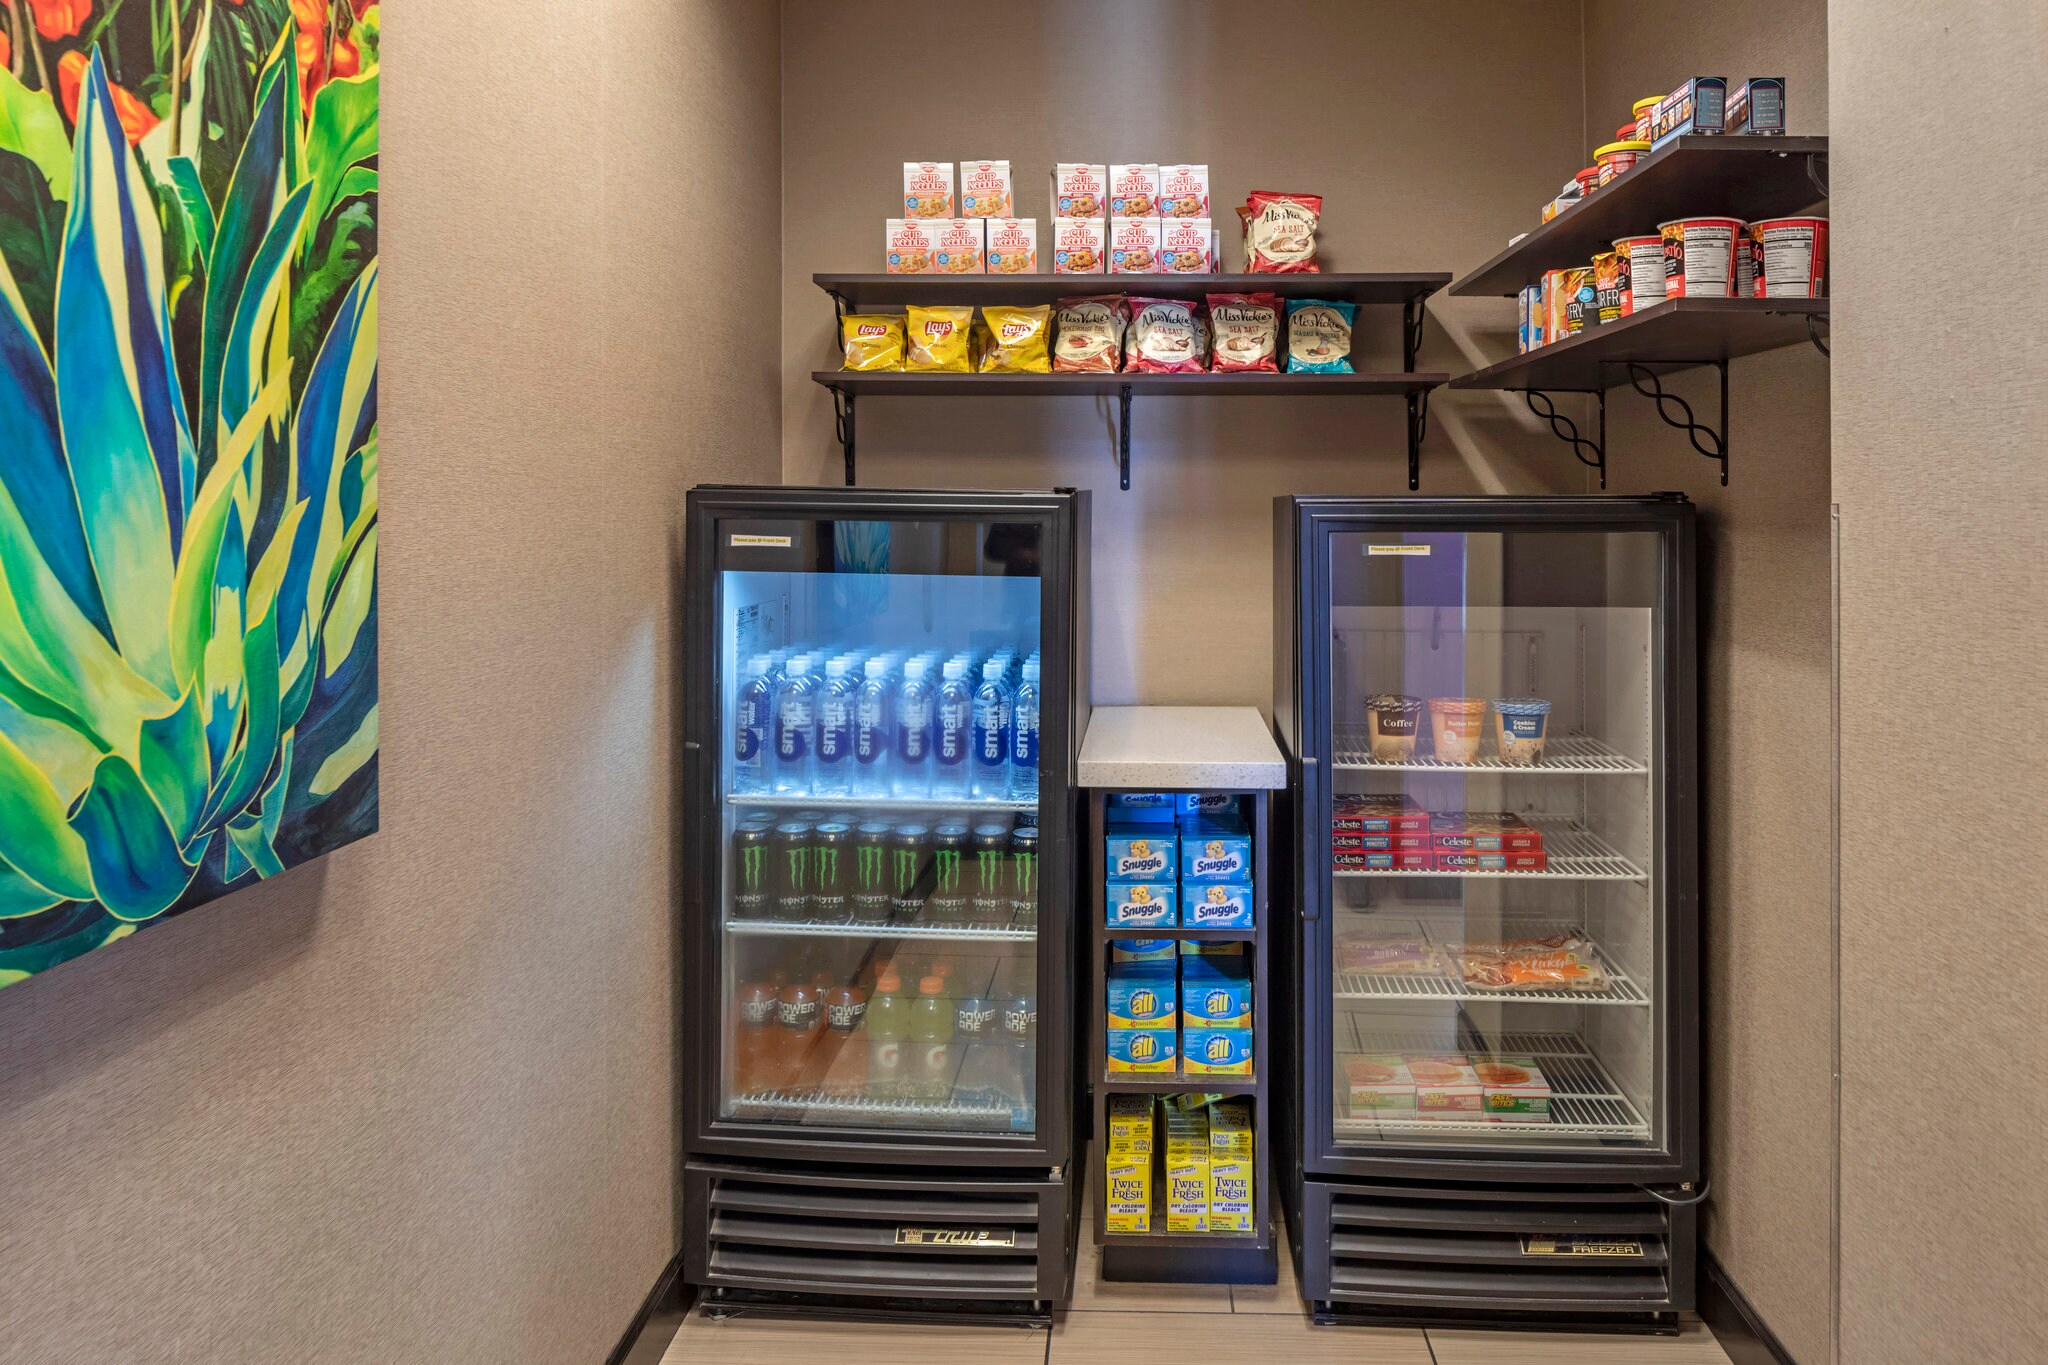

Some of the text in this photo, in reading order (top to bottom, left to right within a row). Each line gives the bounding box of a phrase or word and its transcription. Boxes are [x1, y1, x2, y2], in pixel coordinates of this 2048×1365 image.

[919, 174, 939, 183] CUP
[975, 172, 996, 181] CUP
[1072, 175, 1093, 184] CUP
[1125, 175, 1146, 184] CUP
[1173, 176, 1195, 185] CUP
[911, 181, 947, 191] NOODLES
[967, 180, 1004, 190] NOODLES
[1063, 183, 1100, 193] NOODLES
[1116, 183, 1153, 193] NOODLES
[1165, 184, 1202, 194] NOODLES
[901, 230, 922, 239] CUP
[949, 230, 970, 239] CUP
[1001, 230, 1022, 239] CUP
[1070, 229, 1091, 238] CUP
[1125, 228, 1147, 237] CUP
[1176, 229, 1197, 238] CUP
[1289, 225, 1305, 234] SALT
[892, 238, 929, 247] NOODLES
[941, 238, 977, 247] NOODLES
[993, 238, 1030, 247] NOODLES
[1060, 236, 1098, 247] NOODLES
[1117, 235, 1155, 245] NOODLES
[1168, 236, 1205, 246] NOODLES
[1142, 312, 1165, 327] Miss
[1215, 306, 1273, 323] Miss Vickie's
[1290, 314, 1314, 327] Miss
[860, 325, 886, 335] Lay's
[926, 322, 952, 335] Lay's
[1003, 324, 1031, 337] Lay's
[1154, 326, 1166, 334] SEA
[1229, 325, 1259, 334] SEA SALT
[737, 700, 748, 753] smart
[1383, 718, 1413, 728] Coffee
[781, 703, 795, 755] smart
[823, 703, 836, 755] smart
[859, 703, 871, 756] smart
[943, 704, 956, 758] smart
[985, 705, 998, 759] smart
[1016, 705, 1029, 759] smart
[1189, 793, 1228, 807] Snuggle
[1332, 819, 1361, 829] Celeste
[1332, 837, 1361, 846] Celeste
[1442, 837, 1472, 846] Celeste
[1334, 854, 1364, 863] Celeste
[1447, 856, 1476, 865] Celeste
[1121, 857, 1162, 872] Snuggle
[1197, 857, 1237, 872] Snuggle
[1122, 903, 1162, 918] Snuggle
[1198, 903, 1239, 918] Snuggle
[779, 1002, 815, 1014] POWER
[1132, 993, 1154, 1013] all
[1207, 993, 1229, 1013] all
[829, 1015, 850, 1026] ADE
[1005, 1010, 1037, 1023] POWE
[959, 1020, 981, 1032] ADE
[1132, 1037, 1154, 1057] all
[1207, 1039, 1230, 1059] all
[1111, 1178, 1143, 1188] TWICE
[1172, 1178, 1204, 1188] TWICE
[1214, 1176, 1247, 1187] TWICE
[1111, 1188, 1143, 1200] FRESH
[1172, 1188, 1204, 1200] FRESH
[1214, 1187, 1247, 1199] FRESH
